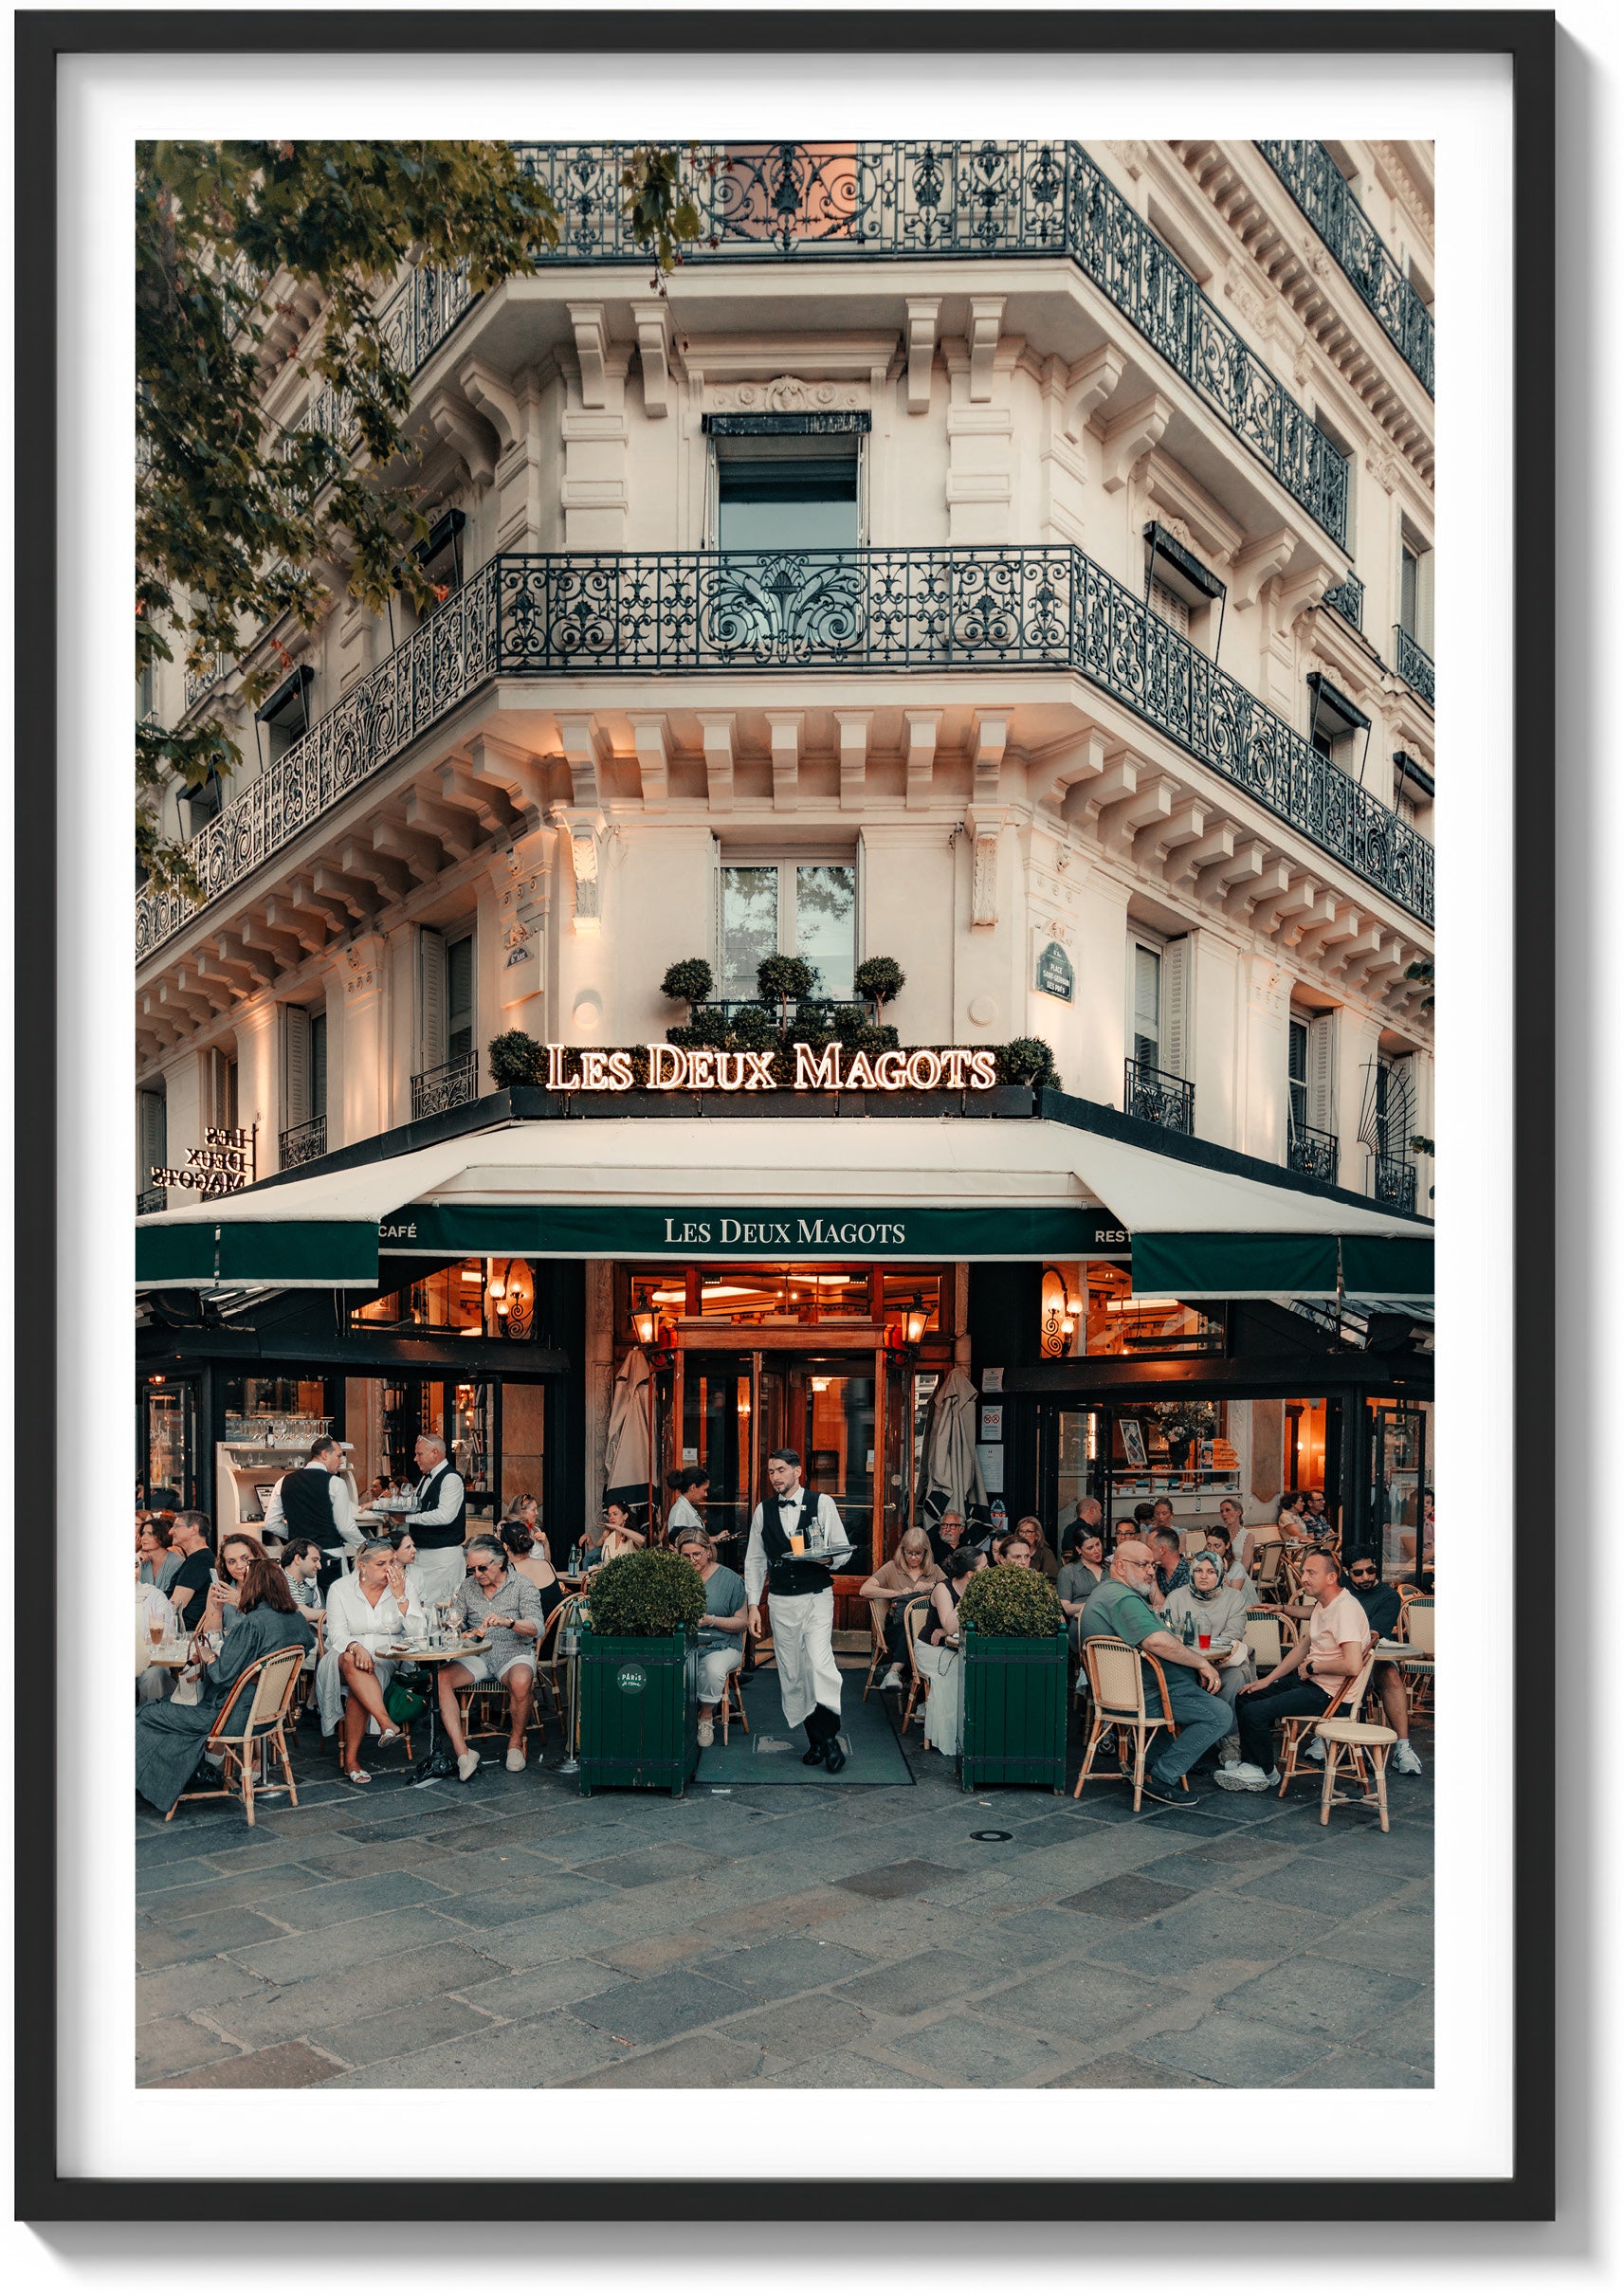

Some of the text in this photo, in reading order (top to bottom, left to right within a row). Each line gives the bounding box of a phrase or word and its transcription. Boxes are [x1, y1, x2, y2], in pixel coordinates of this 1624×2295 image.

[1049, 963, 1063, 974] PLACE
[545, 1042, 996, 1091] LES DEUX MAGOTS
[378, 1222, 417, 1238] CAFÉ
[664, 1218, 905, 1244] LES DEUX MAGOTS
